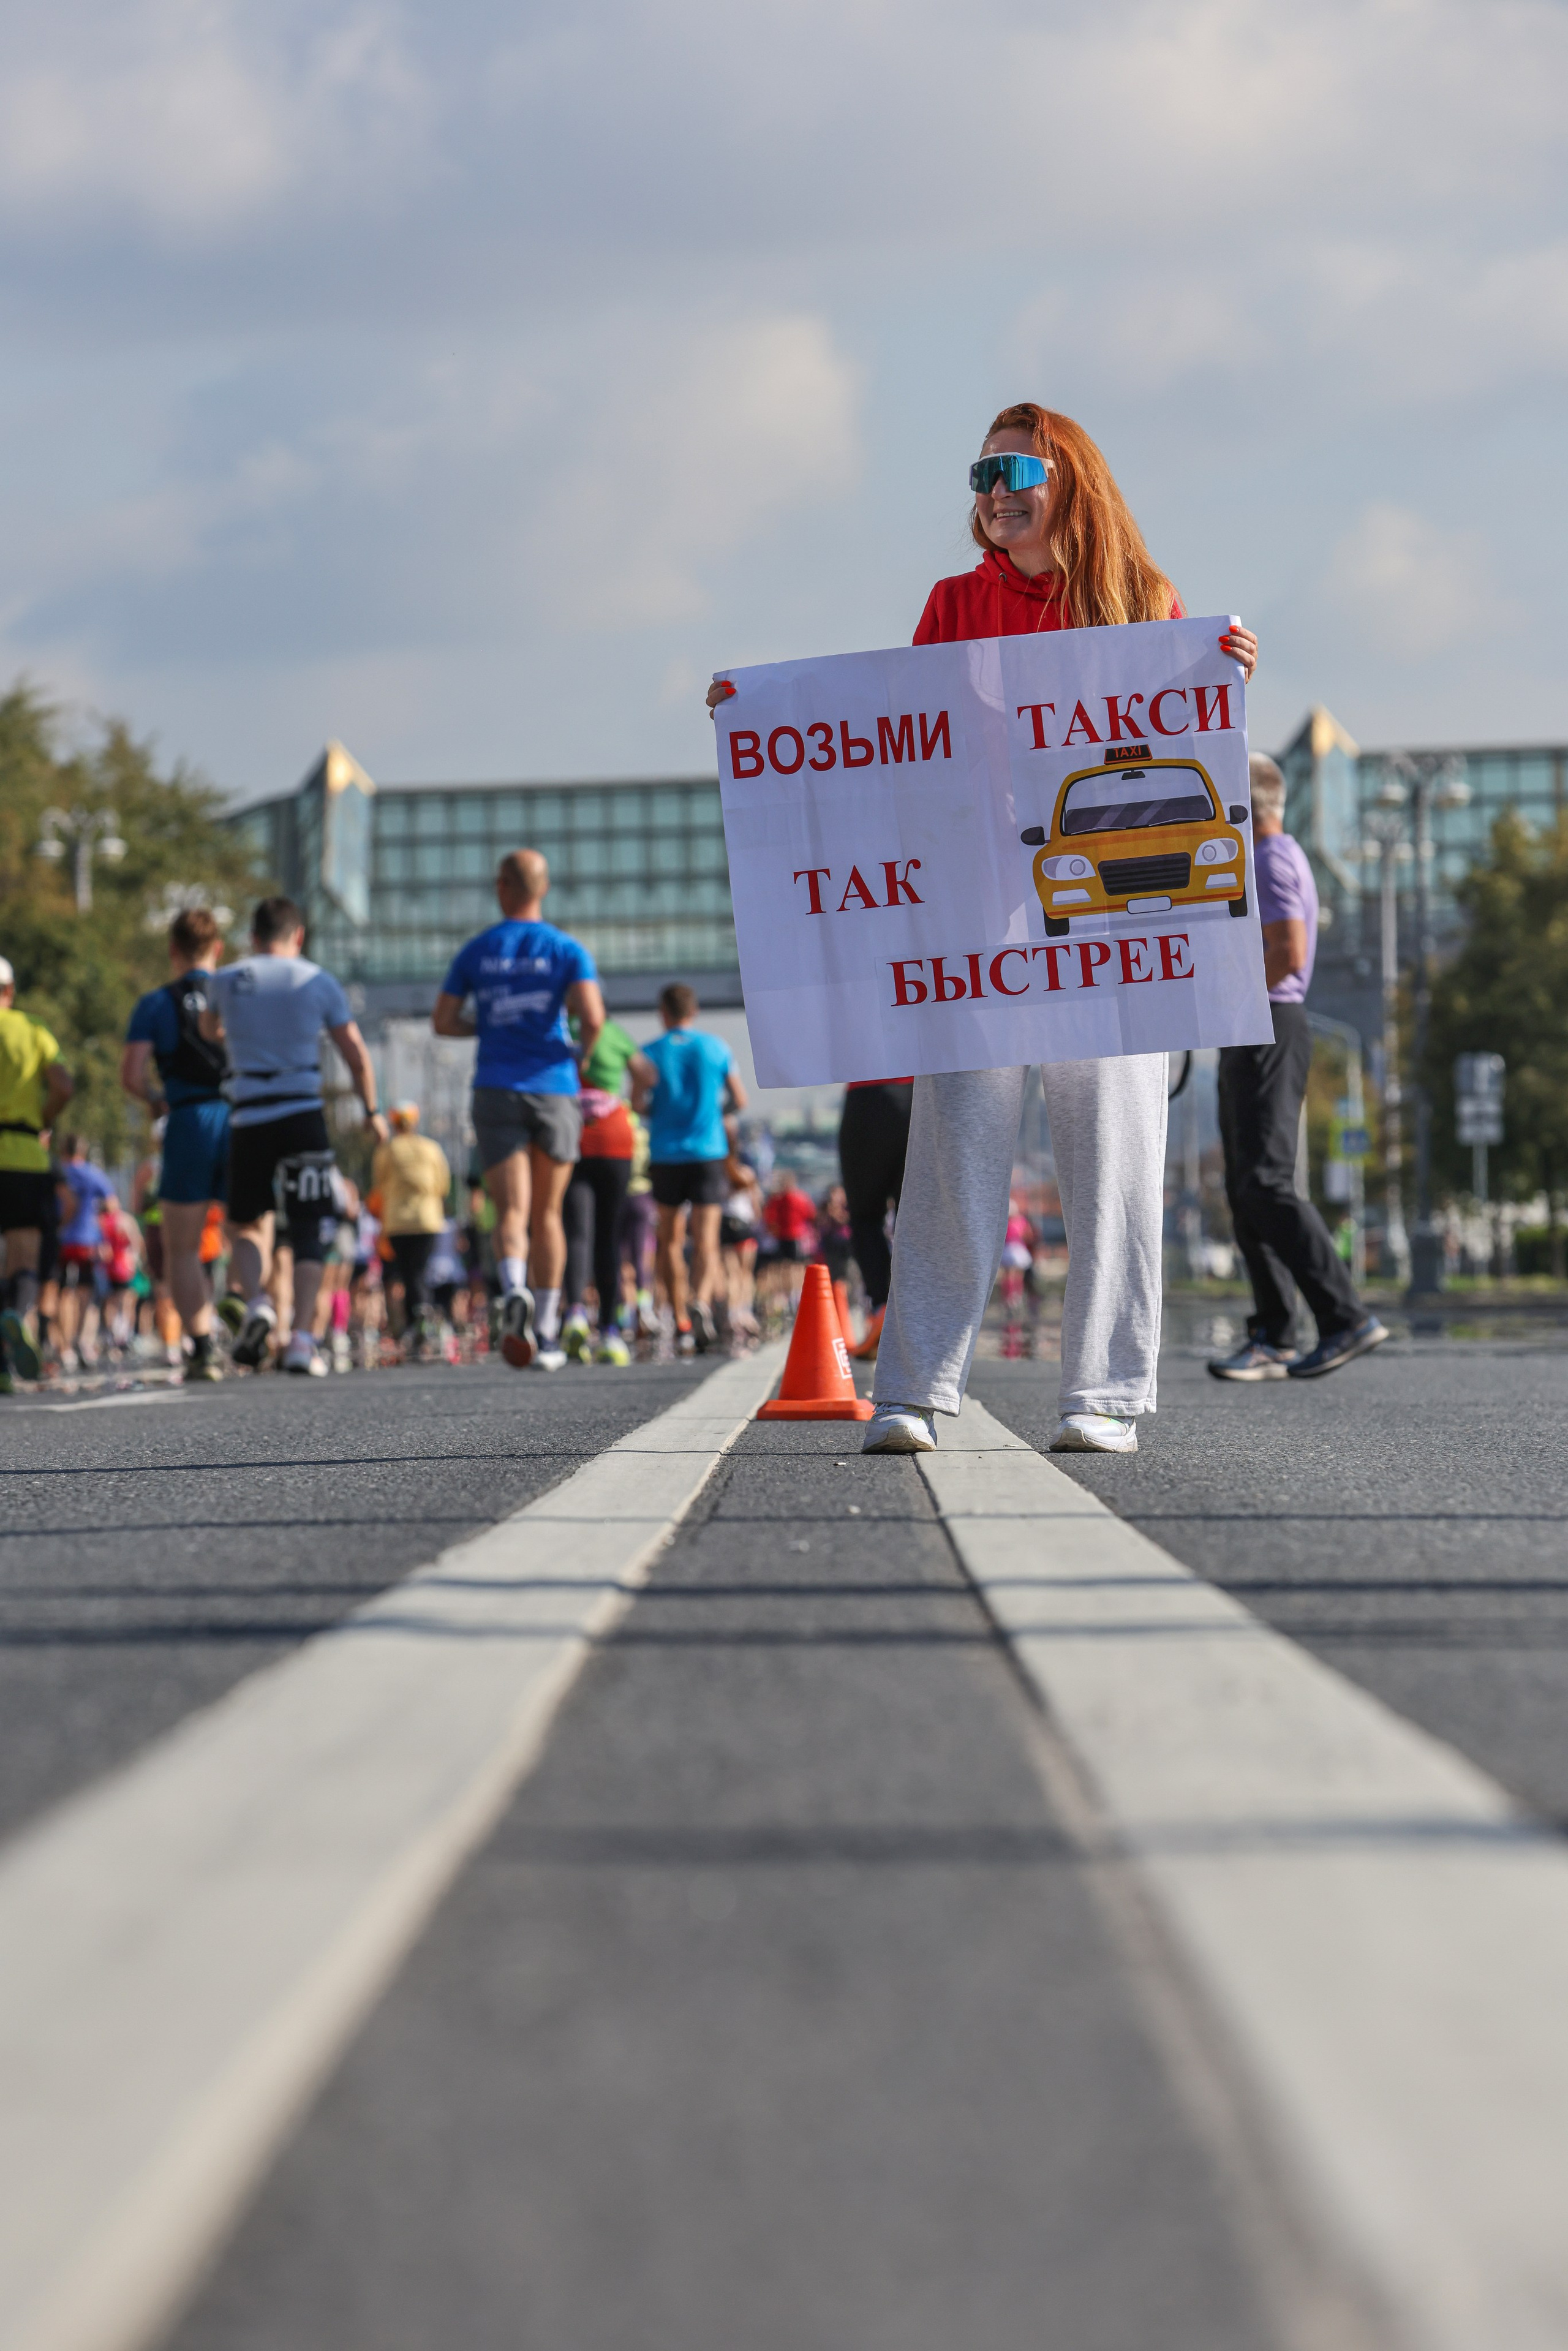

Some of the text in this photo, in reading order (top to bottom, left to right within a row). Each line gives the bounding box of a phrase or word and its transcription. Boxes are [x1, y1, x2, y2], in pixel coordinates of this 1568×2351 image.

[729, 684, 1234, 779] ВОЗЬМИ ТАКСИ
[1113, 745, 1142, 758] TAXI
[794, 858, 925, 915] ТАК
[887, 934, 1195, 1007] БЫСТРЕЕ
